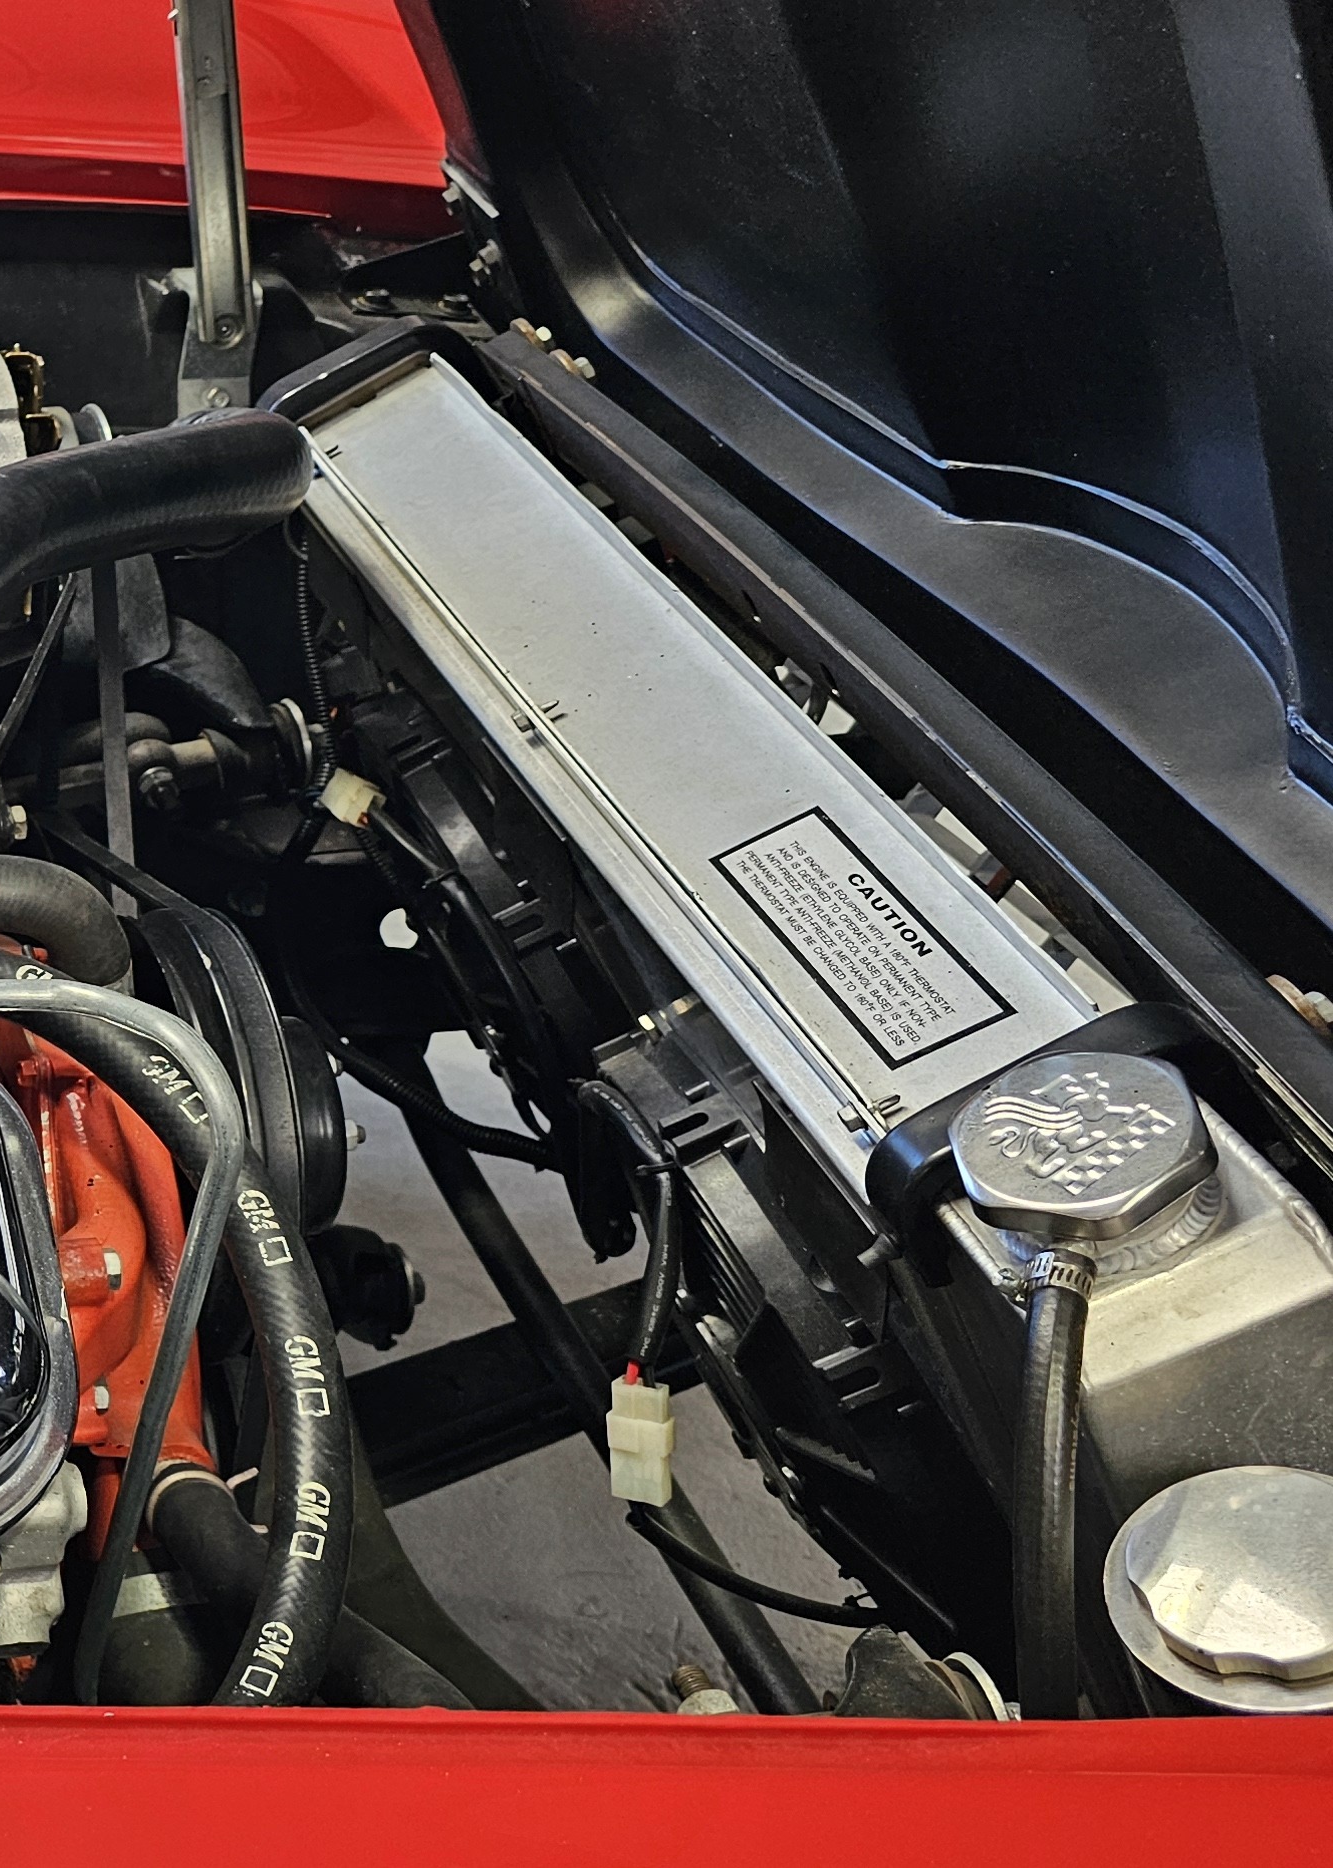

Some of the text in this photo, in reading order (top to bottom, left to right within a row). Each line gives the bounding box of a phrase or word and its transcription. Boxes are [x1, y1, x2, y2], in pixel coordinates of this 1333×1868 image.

[736, 859, 752, 874] THE
[748, 873, 790, 915] THERMOSTAT
[785, 915, 807, 934] MUST
[802, 935, 817, 946] BE
[812, 946, 846, 980] CHANGED
[843, 980, 856, 991] TO
[872, 1013, 886, 1026] OR
[882, 1025, 905, 1046] LESS
[744, 850, 783, 888] PERMANENT
[779, 888, 799, 906] TYPE
[794, 907, 837, 949] ANTI-FREEZE
[831, 949, 872, 989] (METHANOL
[868, 988, 893, 1012] BASE)
[889, 1011, 901, 1020] IS
[763, 853, 804, 893] ANTI-FREEZE
[798, 893, 837, 929] (ETHYLENE
[834, 929, 861, 957] GLYCOL
[858, 956, 882, 978] BASE)
[897, 999, 910, 1007] IF
[905, 1008, 926, 1027] NON-
[776, 847, 941, 1021] AND IS DESIGNED TO OPERATE ON PERMANENT TYPE
[789, 840, 807, 856] THIS
[803, 855, 830, 881] ENGINE
[825, 880, 837, 889] IS
[833, 888, 868, 922] EQUIPPED
[865, 922, 886, 941] WITH
[888, 948, 911, 966] 180°F
[907, 967, 956, 1014] THERMOSTAT
[847, 873, 932, 957] CAUTION
[15, 964, 54, 981] G
[237, 1189, 279, 1235] GM
[285, 1334, 324, 1381] GM
[295, 1481, 332, 1532] GM
[253, 1621, 294, 1671] GM
